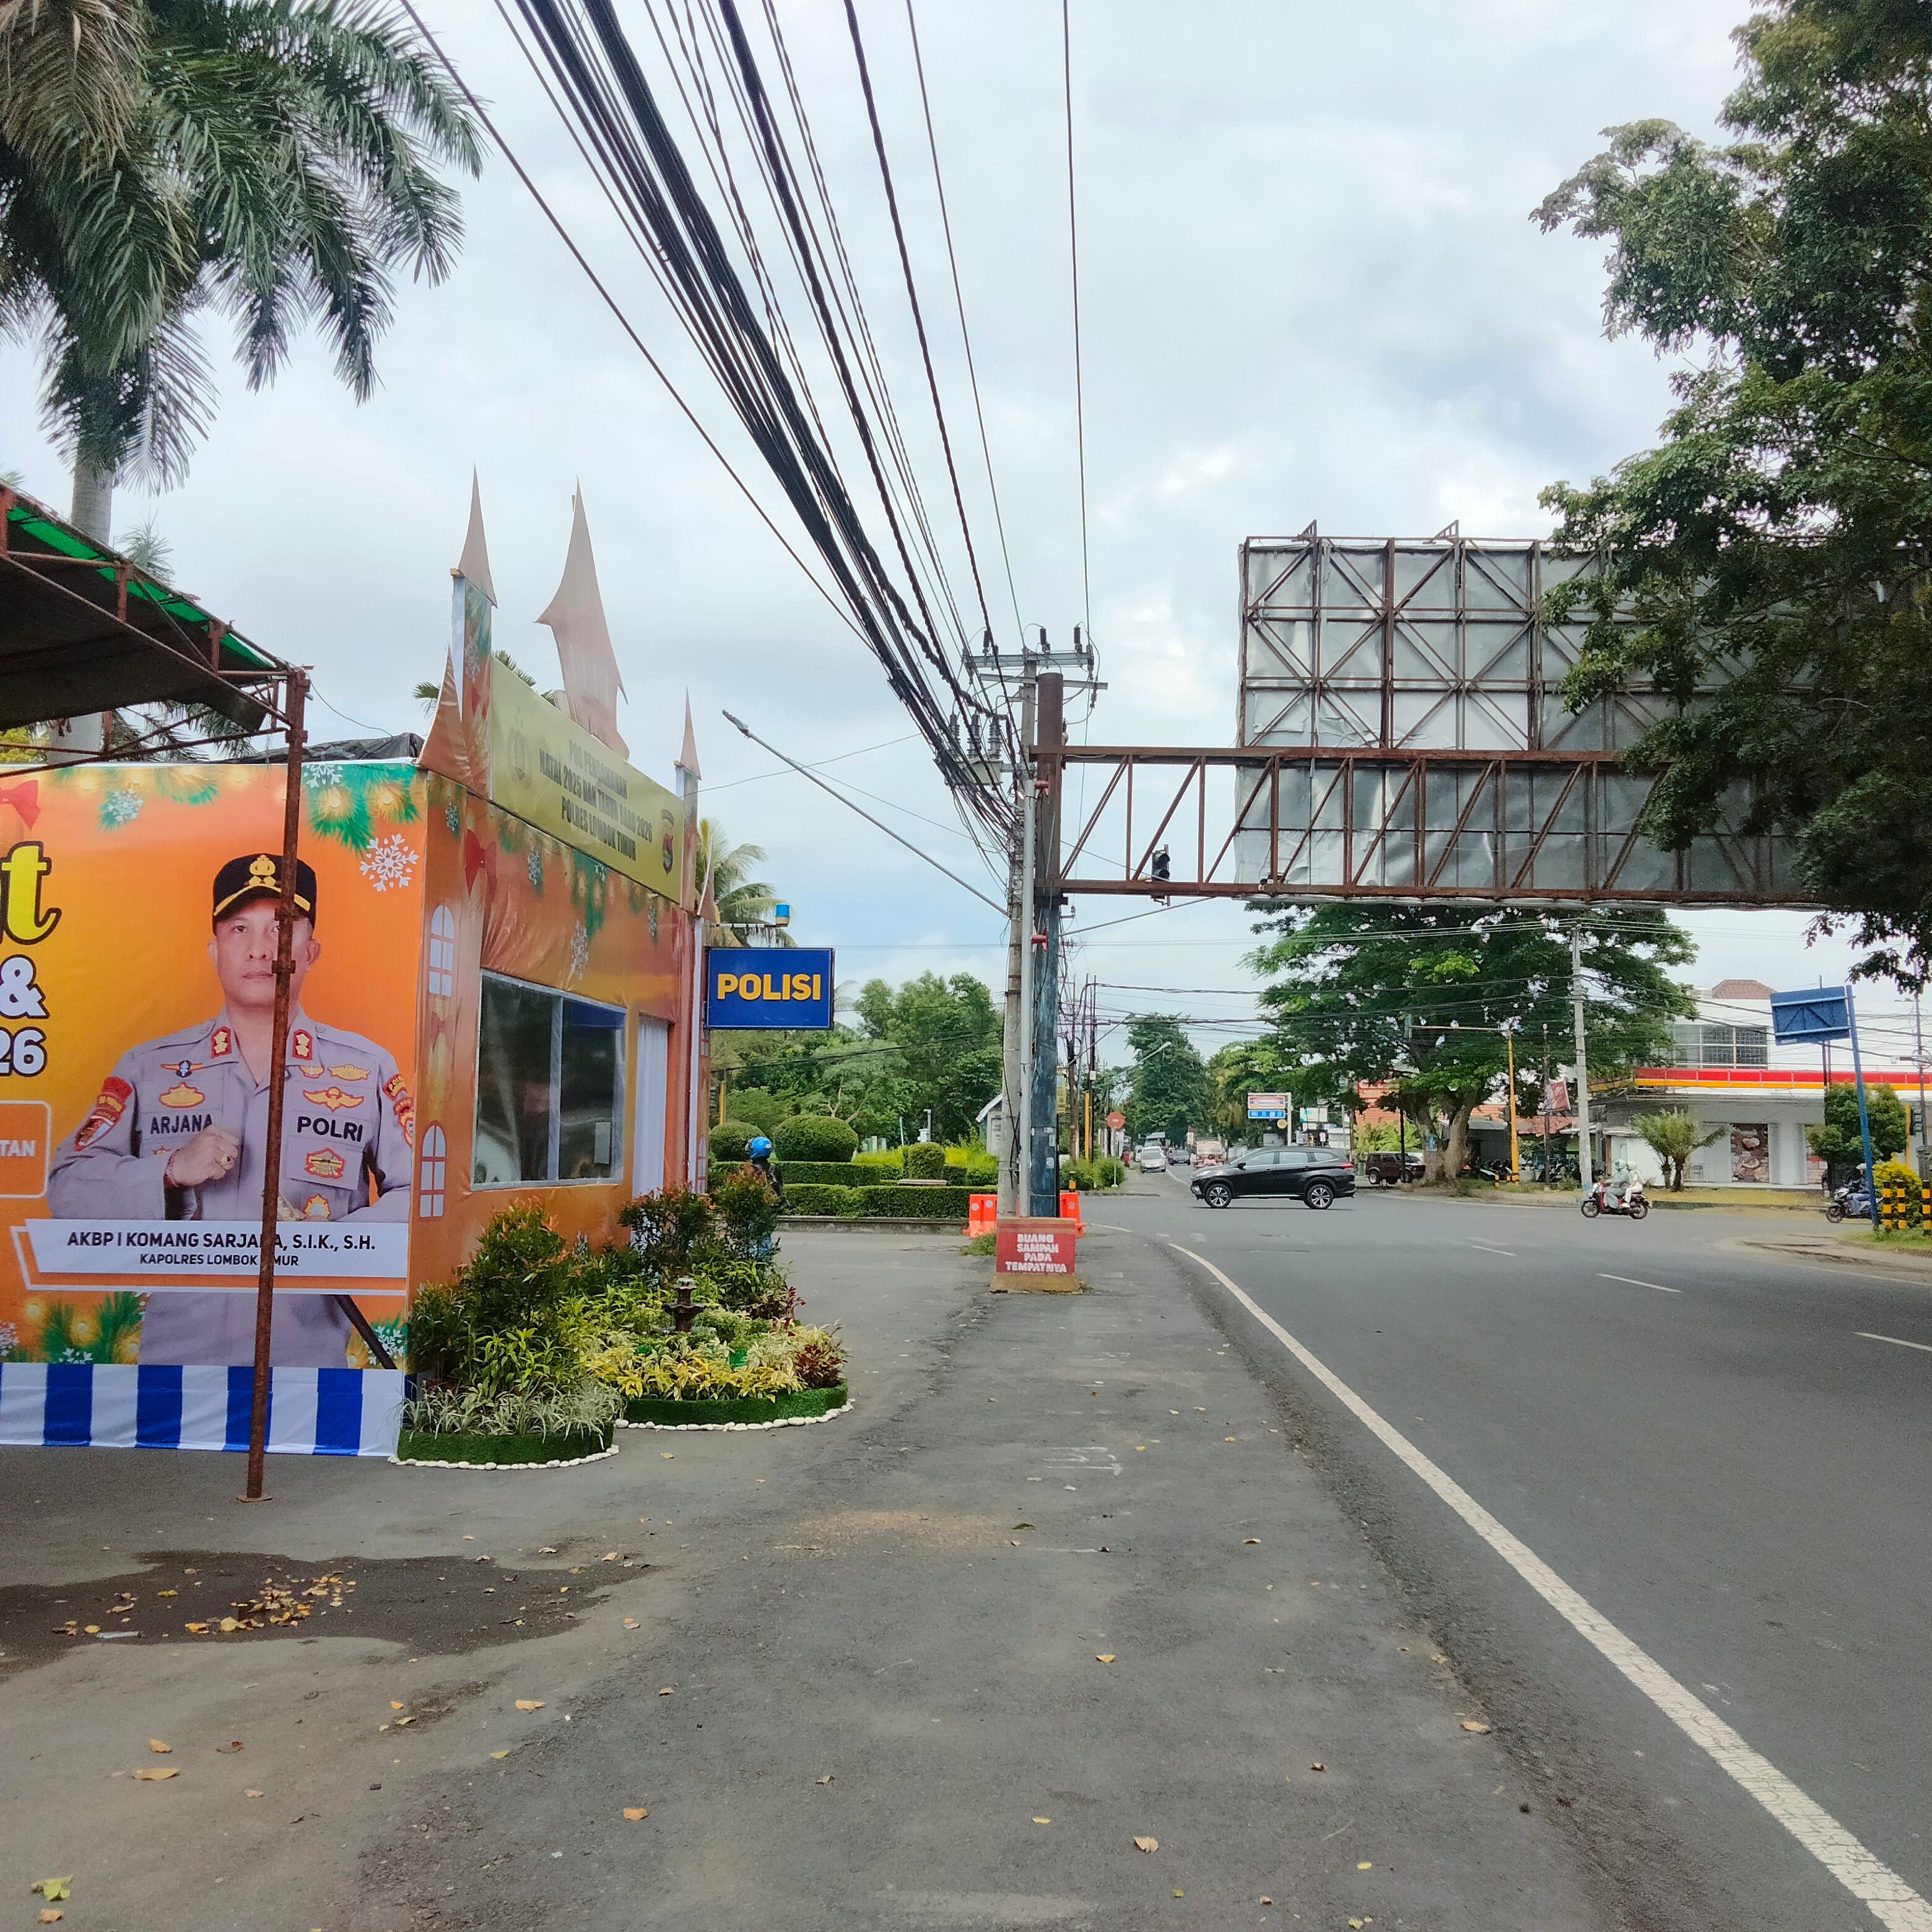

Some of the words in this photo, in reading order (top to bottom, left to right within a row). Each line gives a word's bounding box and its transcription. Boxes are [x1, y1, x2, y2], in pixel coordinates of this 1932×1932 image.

[539, 749, 562, 786] NATAL
[564, 765, 581, 799] 2025
[583, 778, 596, 808] DAN
[598, 789, 618, 822] TAHUN
[637, 816, 652, 843] 2026
[562, 796, 588, 833] POLRES
[590, 812, 616, 850] LOMBOK
[617, 830, 636, 861] TIMUR
[718, 973, 821, 1000] POLISI
[150, 1114, 212, 1134] ARJANA
[297, 1116, 363, 1142] POLRI
[67, 1232, 114, 1247] AKBP
[117, 1232, 122, 1247] I
[126, 1232, 199, 1248] KOMANG
[203, 1233, 288, 1251] SARJAA,
[292, 1234, 339, 1251] S.I.K.,
[343, 1235, 376, 1250] S.H.
[1017, 1234, 1054, 1243] BUANG
[1017, 1243, 1059, 1253] SAMPAH
[139, 1253, 204, 1264] KAPOLRES
[207, 1254, 258, 1265] LOMBOK
[1024, 1253, 1051, 1261] PADA
[1006, 1261, 1067, 1273] TEMPATNYA
